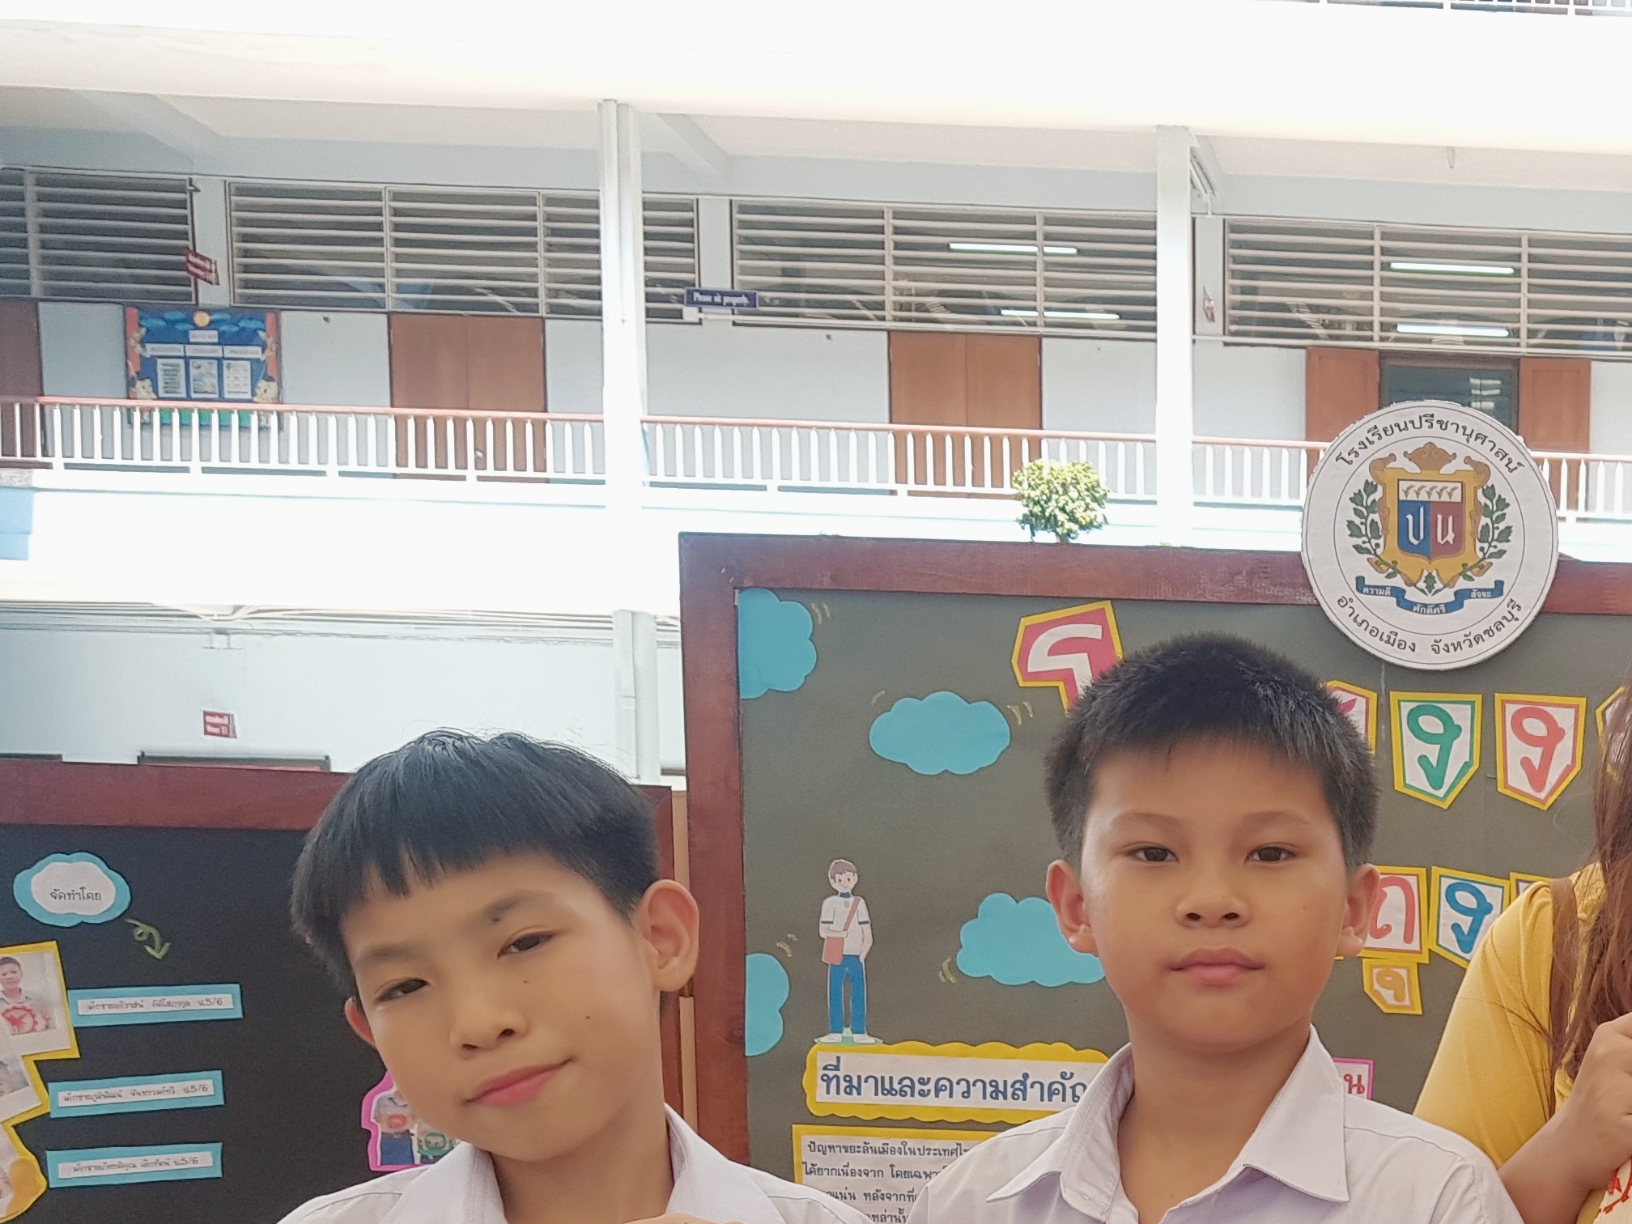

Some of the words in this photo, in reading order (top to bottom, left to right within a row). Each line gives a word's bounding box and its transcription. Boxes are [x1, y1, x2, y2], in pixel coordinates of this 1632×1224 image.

[1335, 412, 1527, 476] โรงเรียนปรีชานุศาสน์
[1336, 594, 1418, 655] อำเภอเมือง
[1429, 597, 1524, 656] จังหวัดชลบุรี
[49, 886, 103, 903] จัดทำโดย
[197, 997, 224, 1007] ป.5/6
[183, 1084, 209, 1094] ป.5/6
[807, 1140, 971, 1159] ปัญหาขยะล้นเมืองในประเทศไ
[173, 1156, 199, 1167] ป.5/6
